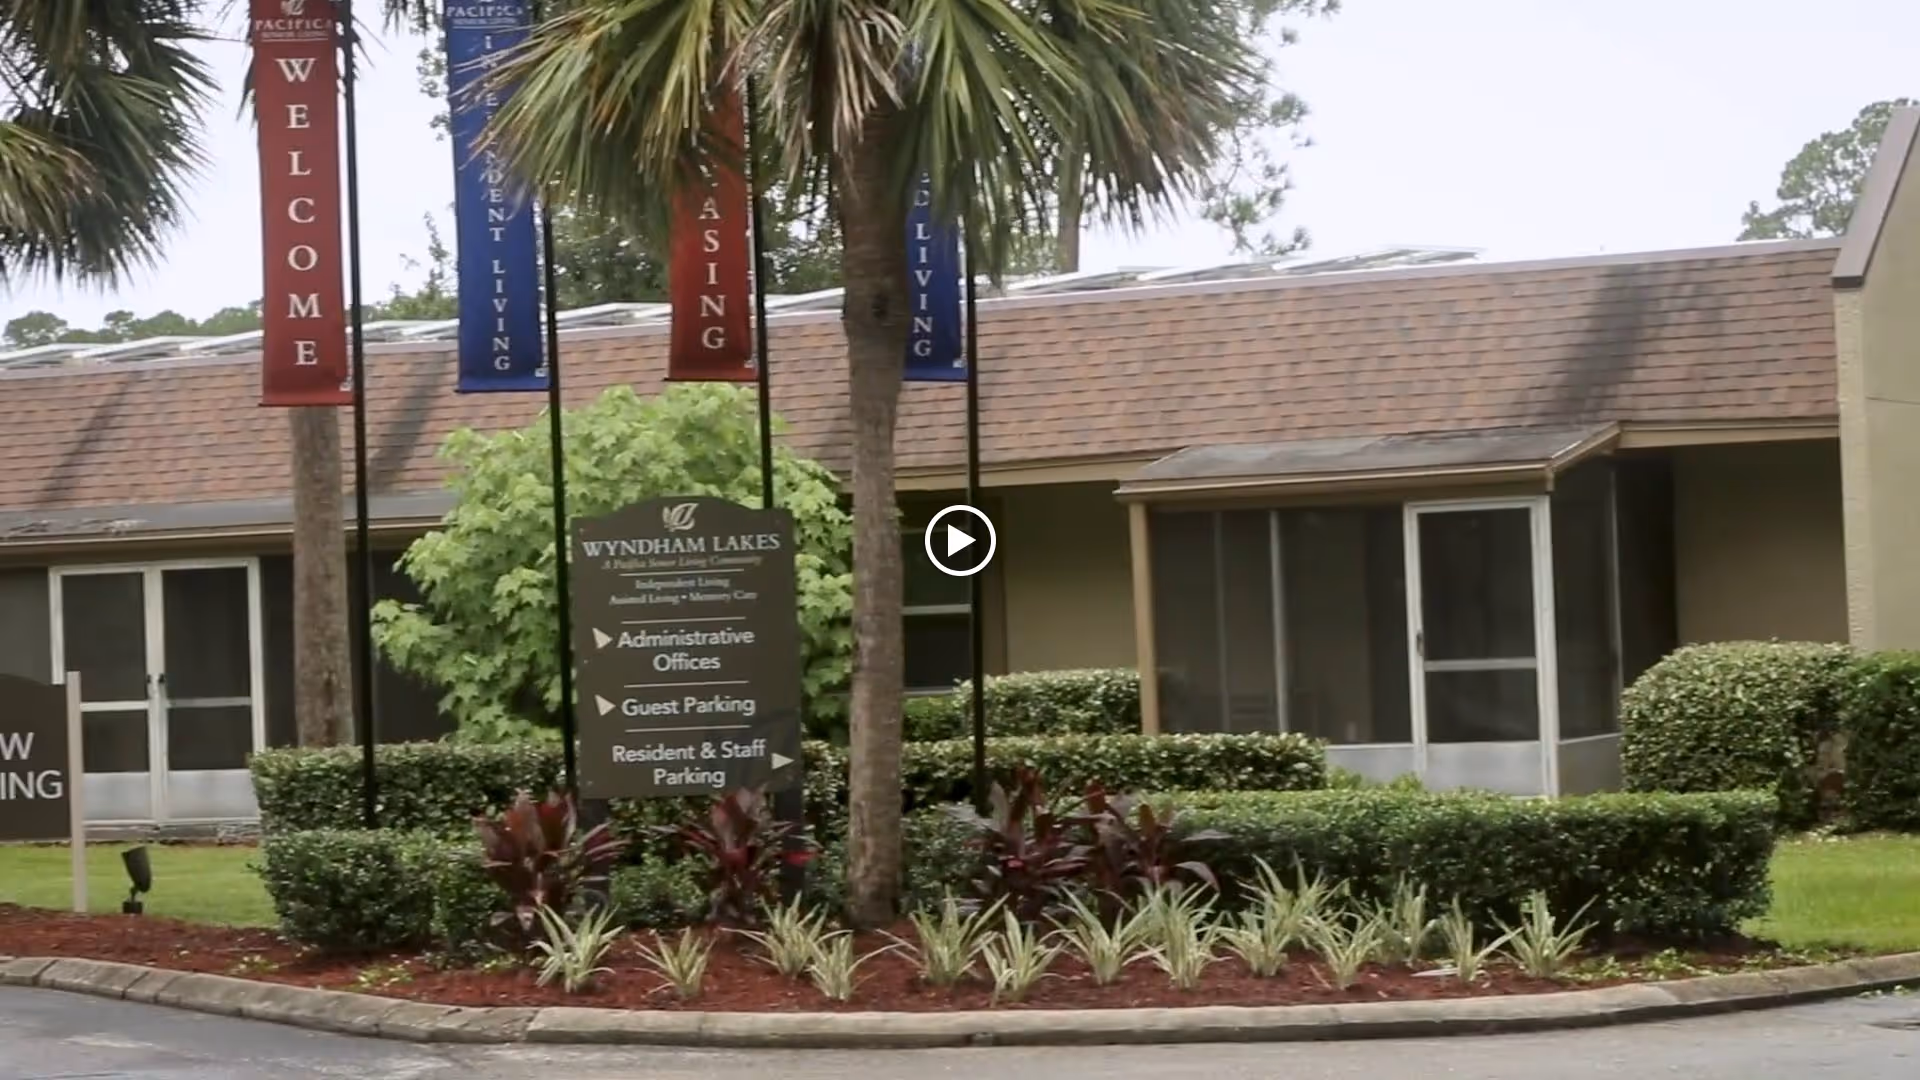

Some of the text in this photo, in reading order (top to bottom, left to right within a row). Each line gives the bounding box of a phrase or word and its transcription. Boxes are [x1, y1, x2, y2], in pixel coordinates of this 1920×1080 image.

[276, 57, 322, 366] WELCOME
[699, 164, 727, 349] ASING
[913, 223, 932, 357] LIVING
[492, 259, 511, 370] LIVING
[582, 533, 780, 557] WYNDHAM LAKES
[617, 627, 755, 648] Administrative
[653, 652, 721, 672] Offices
[621, 695, 756, 717] Guest Parking
[612, 738, 767, 762] Resident & Staff
[653, 767, 726, 788] Parking
